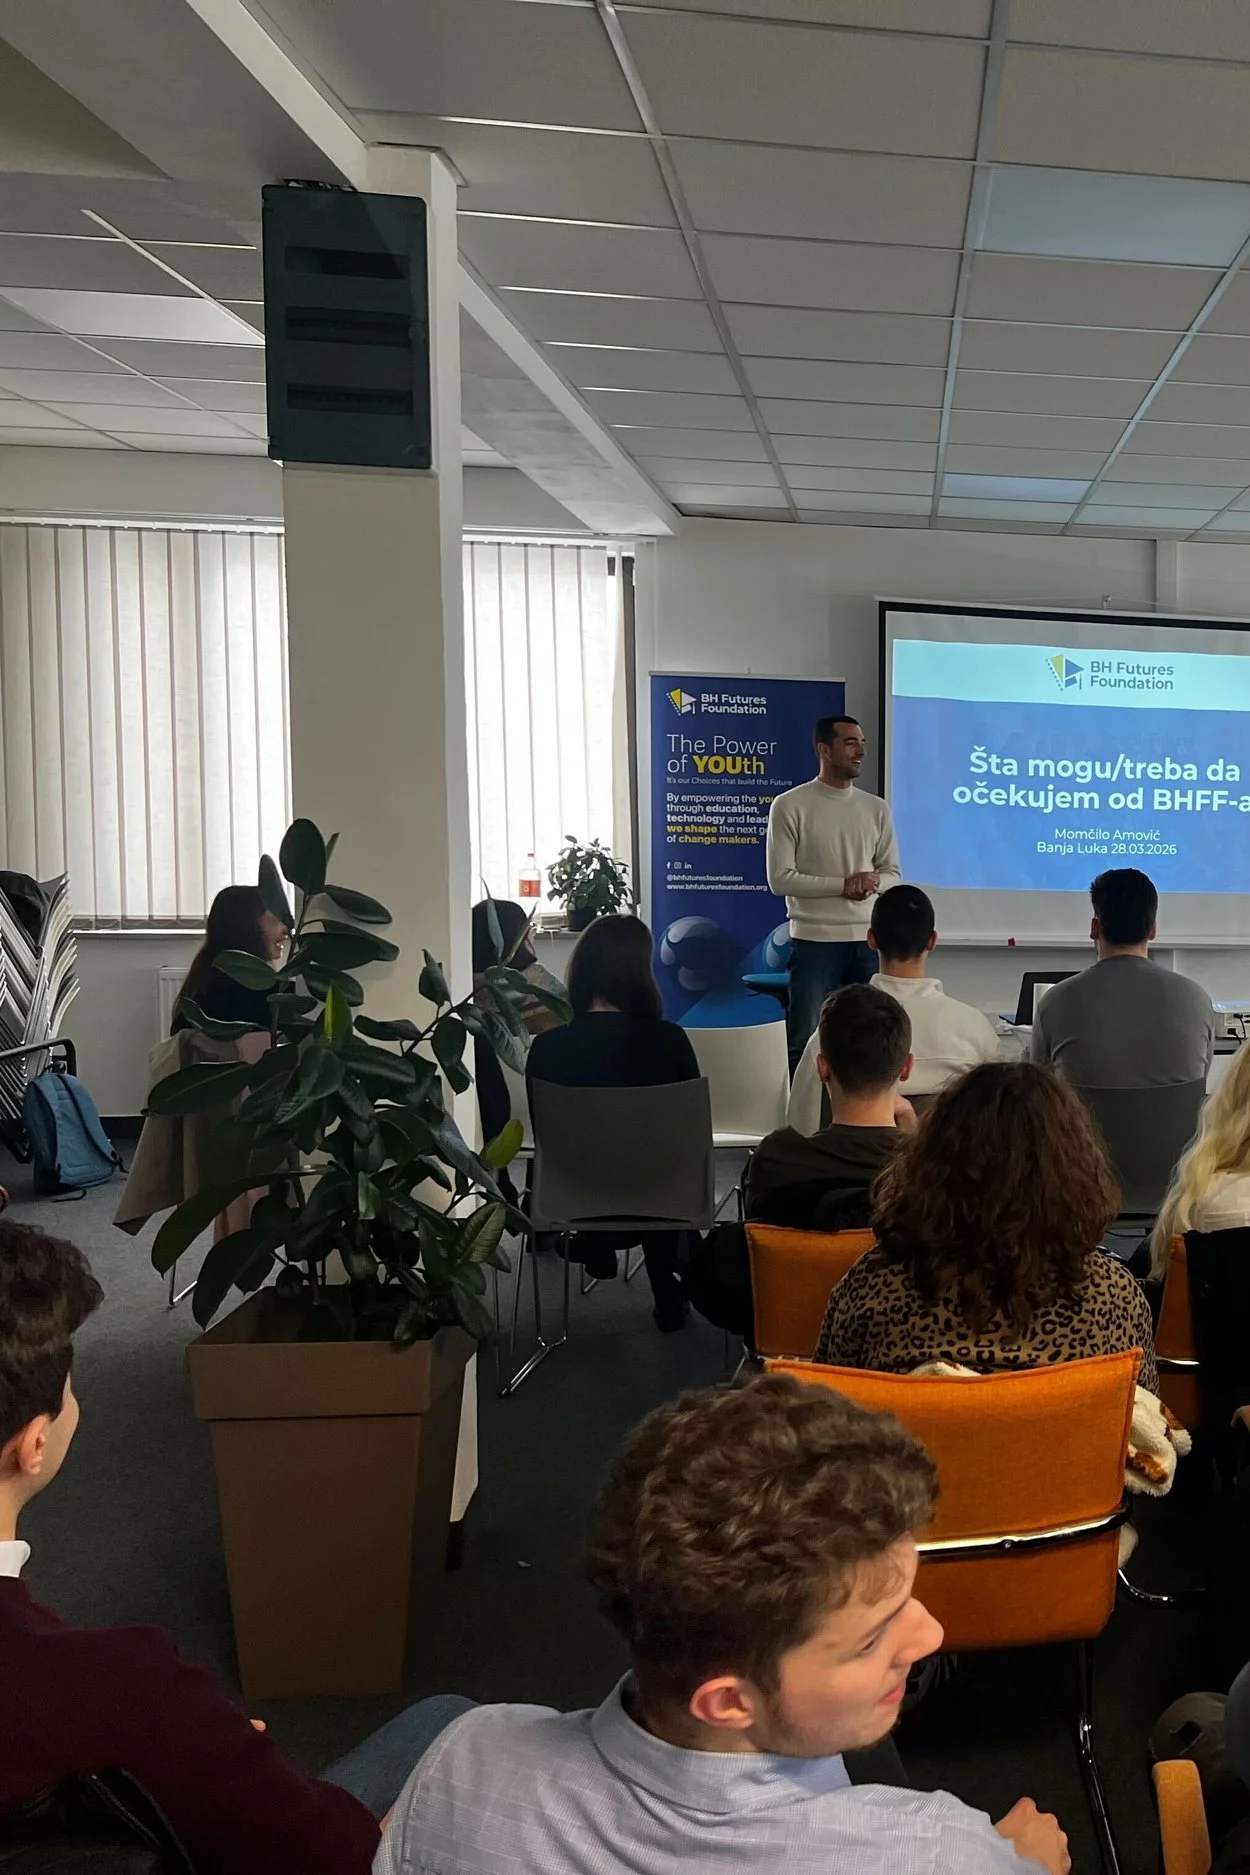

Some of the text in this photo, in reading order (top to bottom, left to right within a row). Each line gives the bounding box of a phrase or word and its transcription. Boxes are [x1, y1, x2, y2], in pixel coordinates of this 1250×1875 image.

[1090, 661, 1174, 676] BH Futures
[1090, 676, 1174, 690] Foundation
[701, 693, 767, 704] BH Futures
[701, 704, 767, 715] Foundation
[666, 734, 777, 755] The Power
[667, 754, 765, 775] of YOUth
[969, 745, 1241, 784] Šta mogu/treba da
[691, 777, 720, 785] Choices
[721, 778, 736, 786] that
[737, 778, 755, 786] build
[769, 779, 793, 787] Future
[666, 792, 680, 803] By
[681, 794, 740, 805] empowering
[741, 795, 757, 804] the
[952, 781, 1100, 813] očekujem
[1108, 787, 1144, 811] od
[666, 803, 760, 815] through education,
[666, 814, 770, 825] technology and lead
[667, 826, 682, 834] we
[684, 825, 718, 836] shape
[719, 826, 735, 835] the
[736, 826, 757, 835] next
[1054, 828, 1161, 842] Momčilo Amović
[666, 834, 760, 846] of change makers.
[1036, 841, 1177, 856] Banja Luka 28.03.2026
